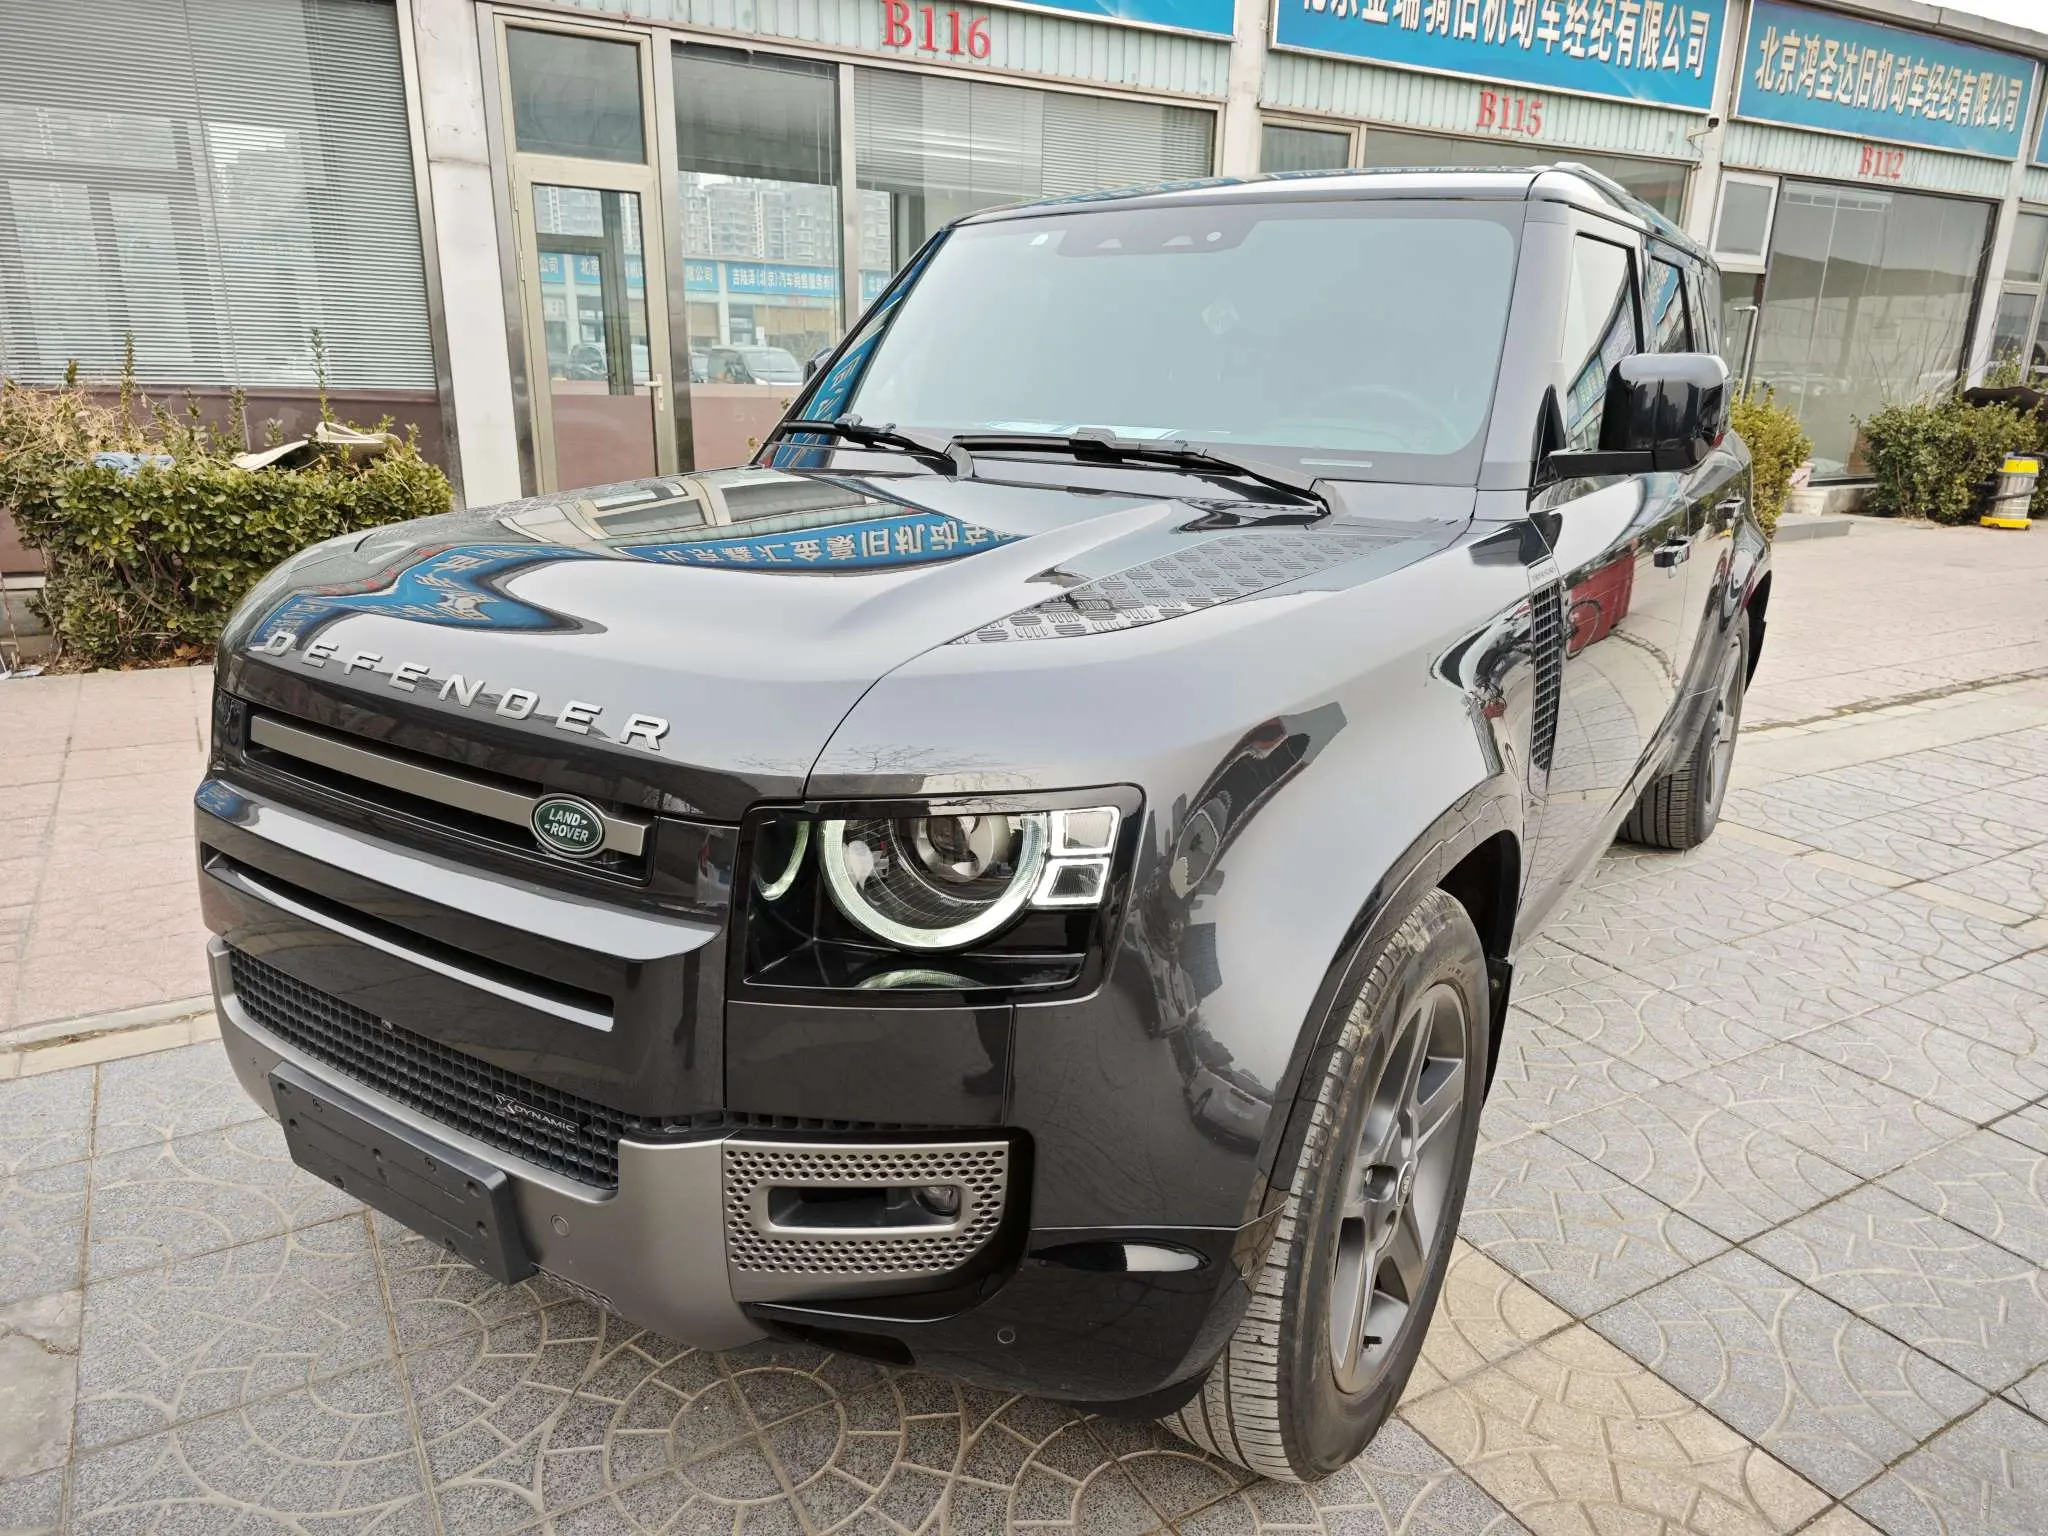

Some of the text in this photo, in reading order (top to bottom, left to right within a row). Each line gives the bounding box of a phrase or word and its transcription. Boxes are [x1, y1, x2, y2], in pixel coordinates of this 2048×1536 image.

[882, 0, 991, 58] B116
[1303, 0, 1711, 78] 旧机动车经纪有限公司
[1755, 25, 2023, 133] 北京鸿圣达旧机动车经纪有限公司
[1476, 90, 1543, 136] B115
[1858, 145, 1904, 179] B112
[264, 630, 671, 751] DEFENDER
[549, 808, 580, 825] LAND
[550, 823, 588, 842] ROVER
